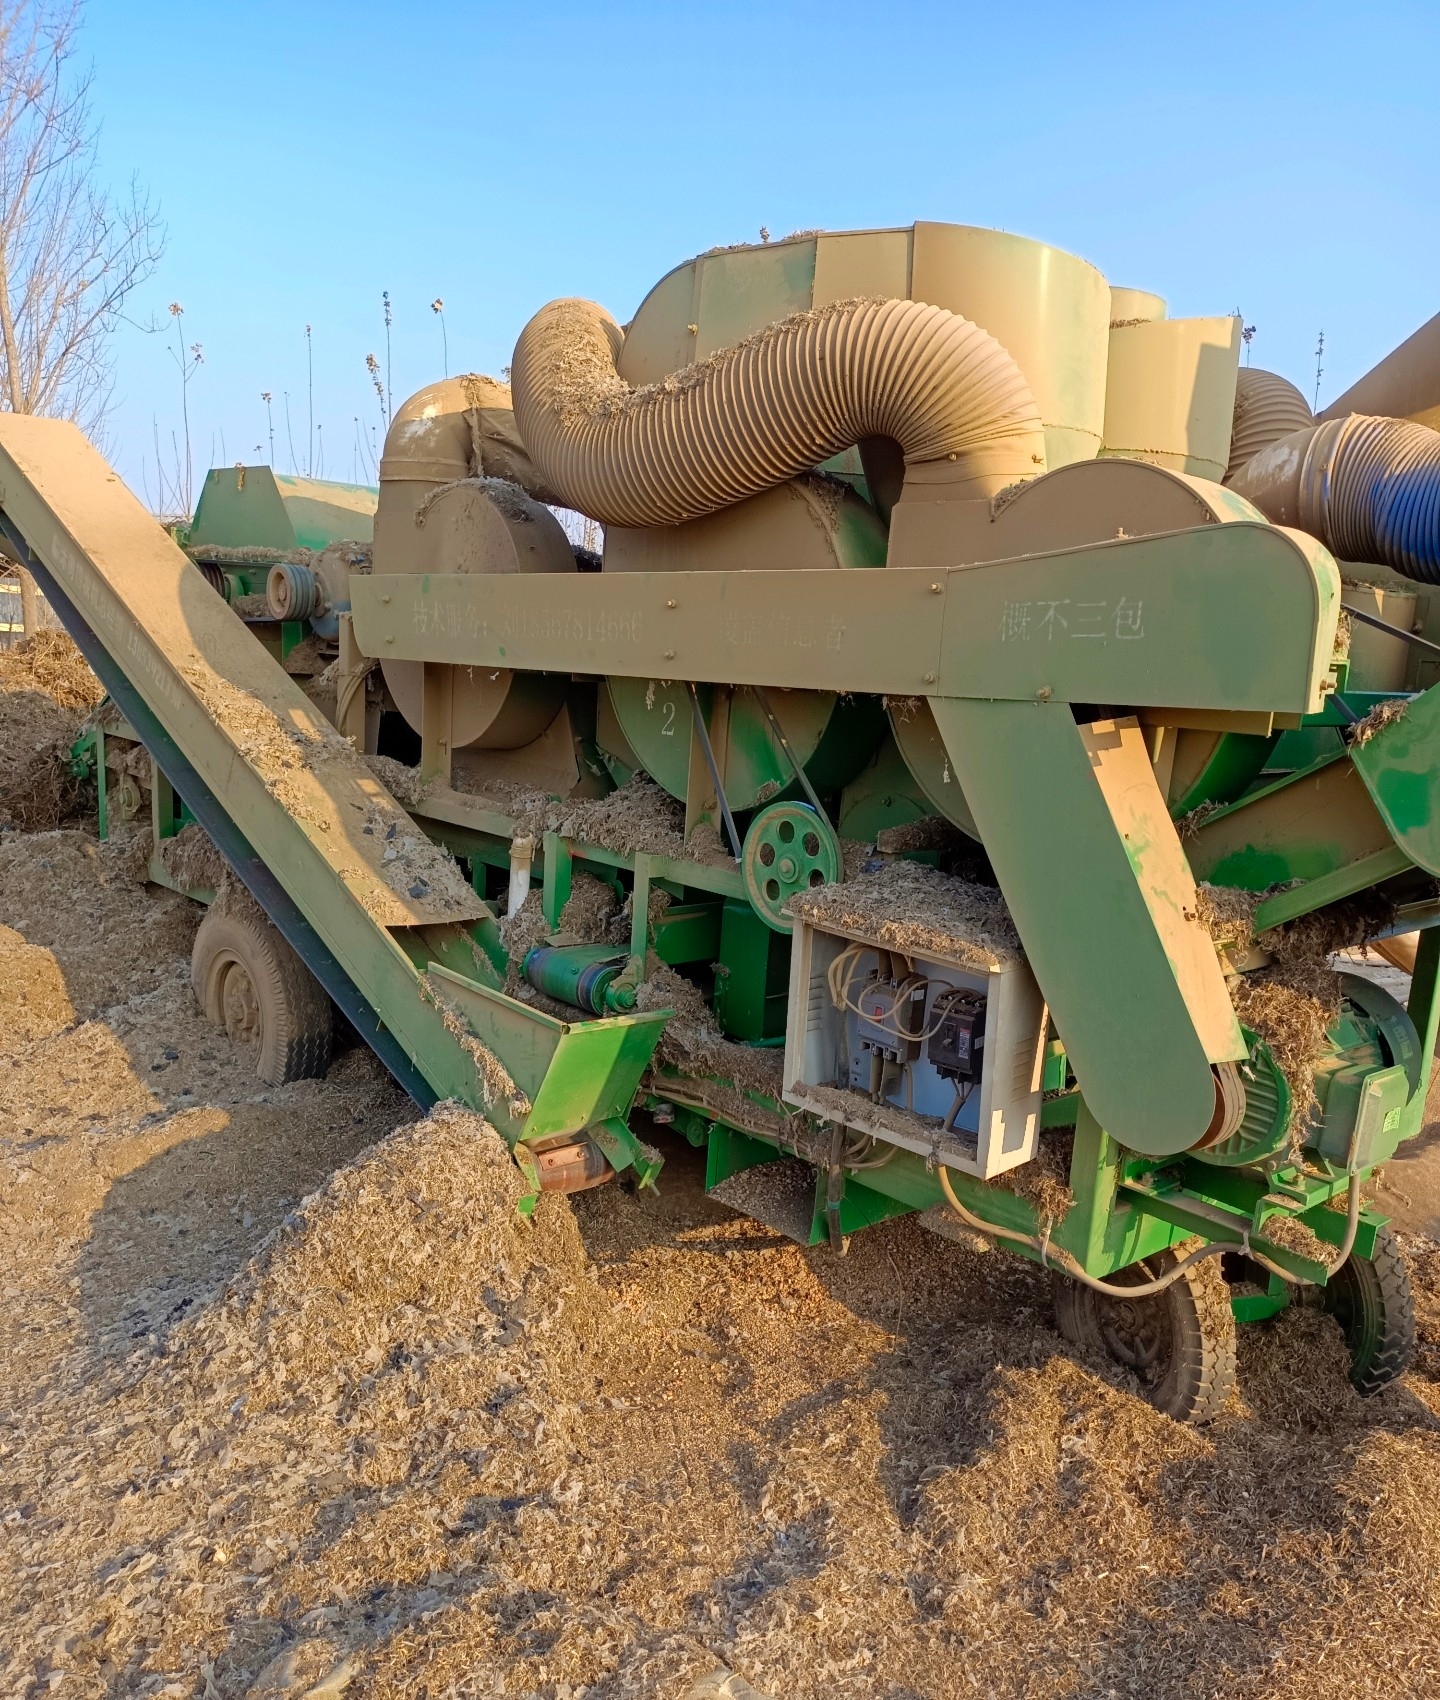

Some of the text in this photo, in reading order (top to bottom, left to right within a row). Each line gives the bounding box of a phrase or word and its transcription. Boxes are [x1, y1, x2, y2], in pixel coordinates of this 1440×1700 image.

[998, 596, 1145, 642] 概不三包
[661, 702, 676, 736] 2
